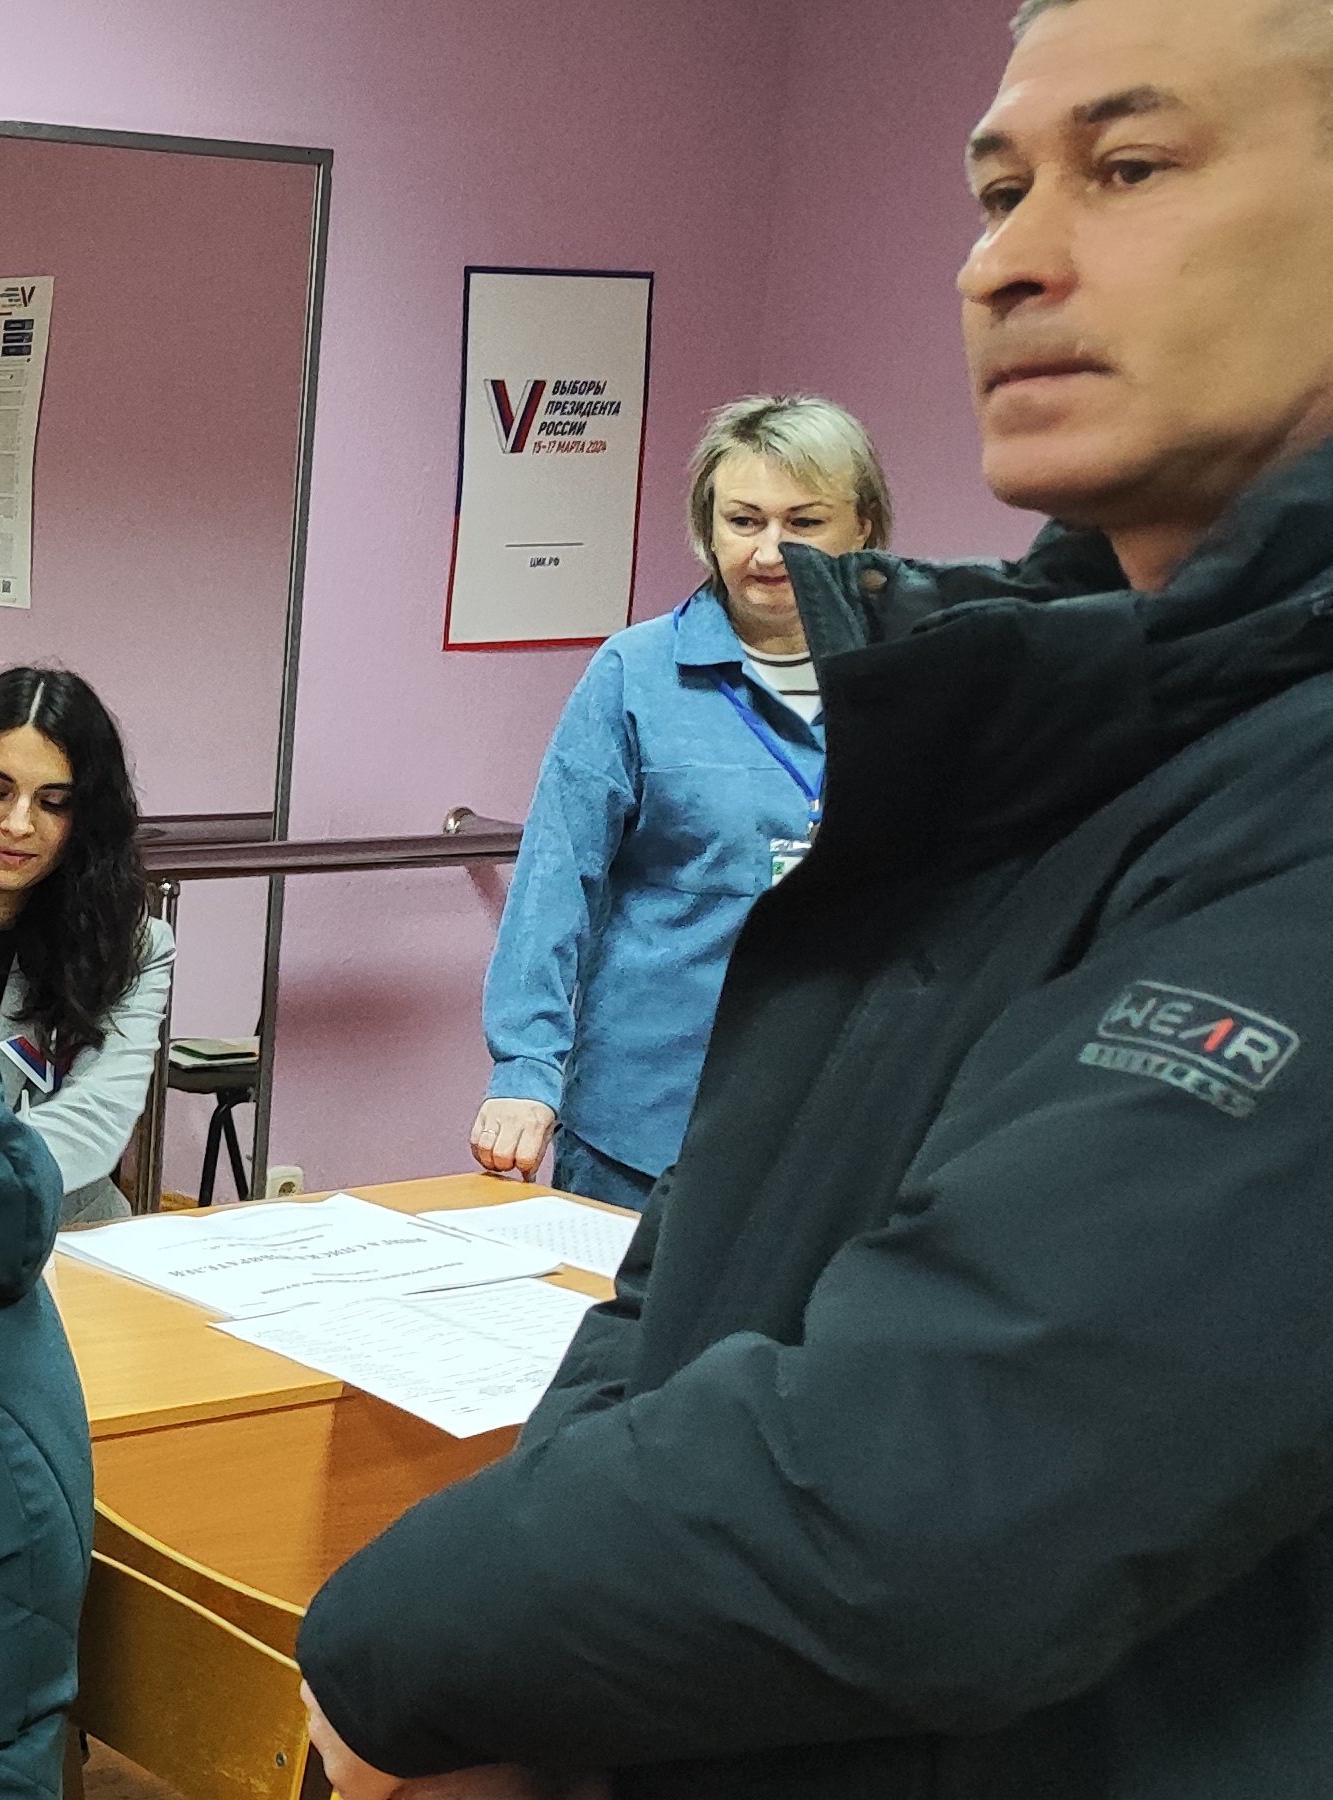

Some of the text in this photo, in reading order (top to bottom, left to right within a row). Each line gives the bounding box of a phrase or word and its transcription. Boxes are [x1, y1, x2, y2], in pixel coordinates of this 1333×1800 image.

[552, 380, 607, 395] ВЫБОРЫ
[544, 400, 621, 418] ПРЕЗИДЕНТА
[537, 420, 587, 436] РОССИИ
